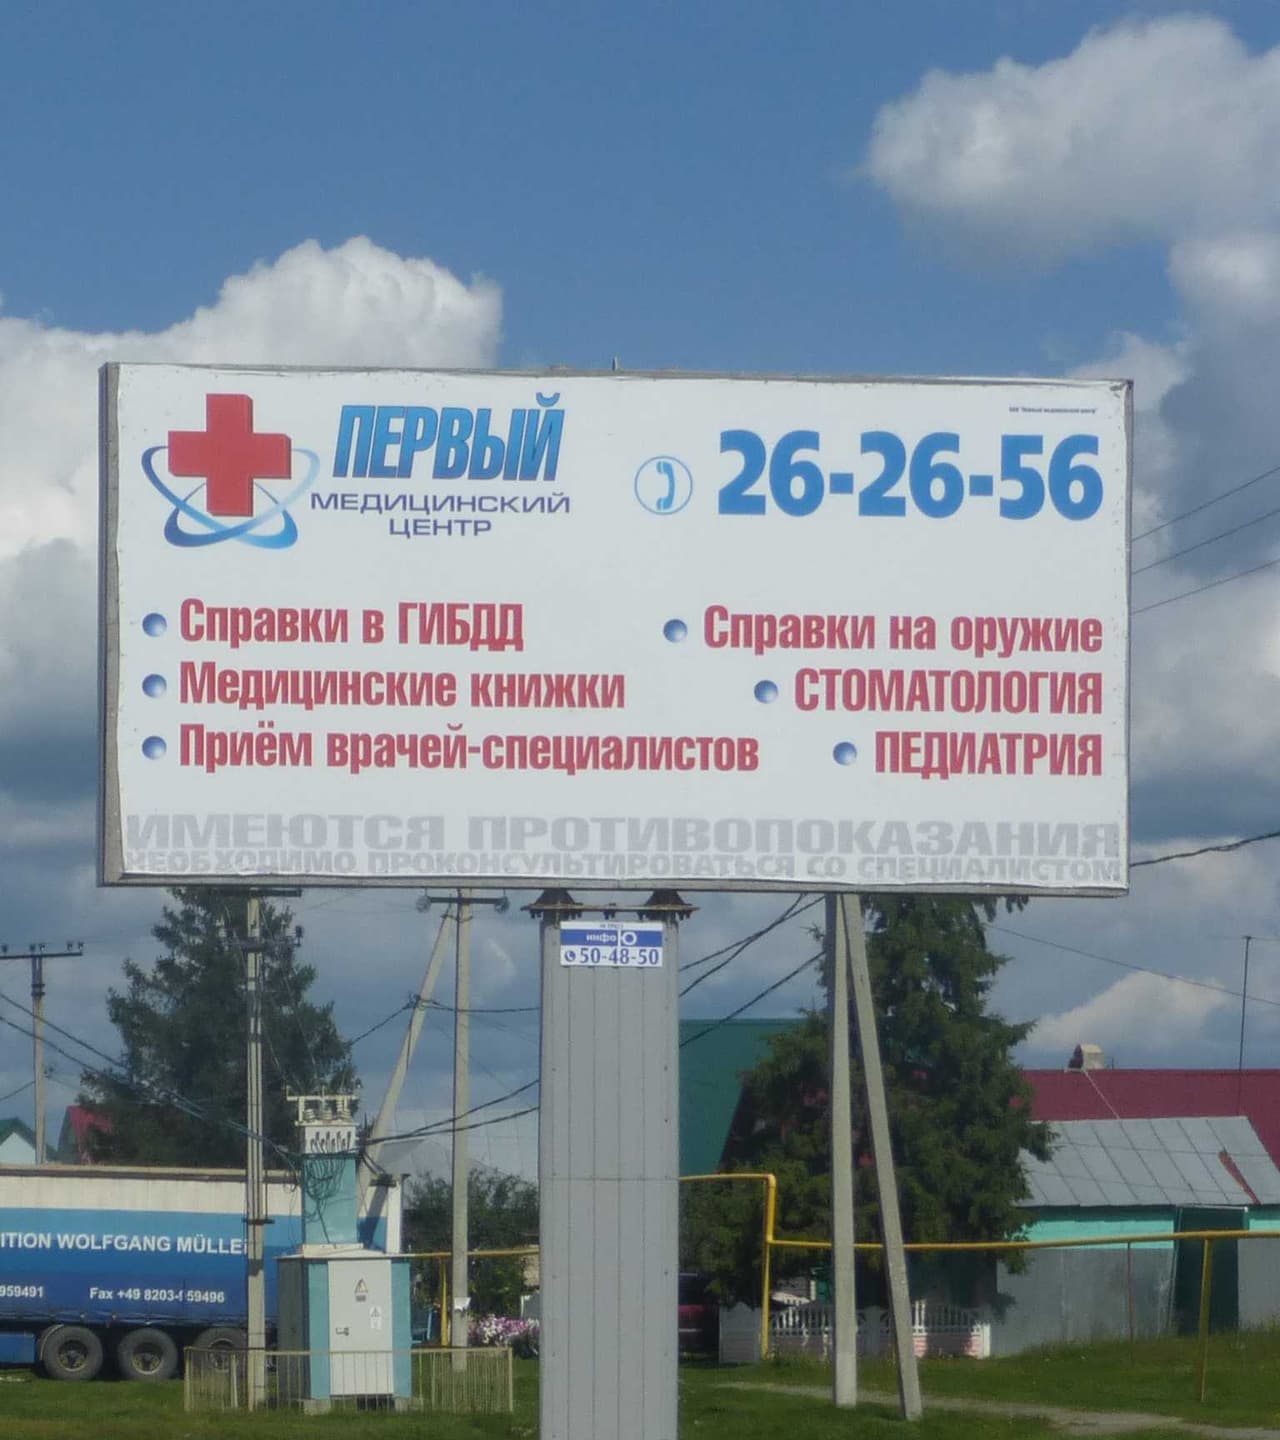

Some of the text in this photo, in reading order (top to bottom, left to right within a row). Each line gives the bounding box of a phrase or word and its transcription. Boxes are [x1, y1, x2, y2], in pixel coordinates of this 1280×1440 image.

[332, 392, 565, 481] ПЕРВЫЙ
[717, 430, 1104, 521] 26-26-56
[310, 492, 571, 515] МЕДИЦИНСКИЙ
[389, 519, 493, 539] ЦЕНТР
[180, 598, 525, 652] Справки в ГИБДД
[703, 604, 1103, 659] Справки на оружие
[180, 661, 625, 711] Медицинские книжки
[794, 668, 1103, 714] СТОМАТОЛОГИЯ
[180, 720, 759, 776] Приём врачей-специалистов
[874, 730, 1103, 780] ПЕДИАТРИЯ
[127, 813, 1120, 858] ИМЕЮТСЯ ПРОТИВОПОКАЗАНИЯ
[367, 851, 796, 879] ПРОКОНСУЛЬТИРОВАТЬСЯ
[806, 855, 847, 879] СО
[856, 855, 1122, 884] СПЕЦИАЛИСТОМ
[580, 947, 659, 965] 50-48-50
[57, 1233, 171, 1251] WOLFGANG
[89, 1287, 113, 1299] Fax
[117, 1288, 140, 1300] +49
